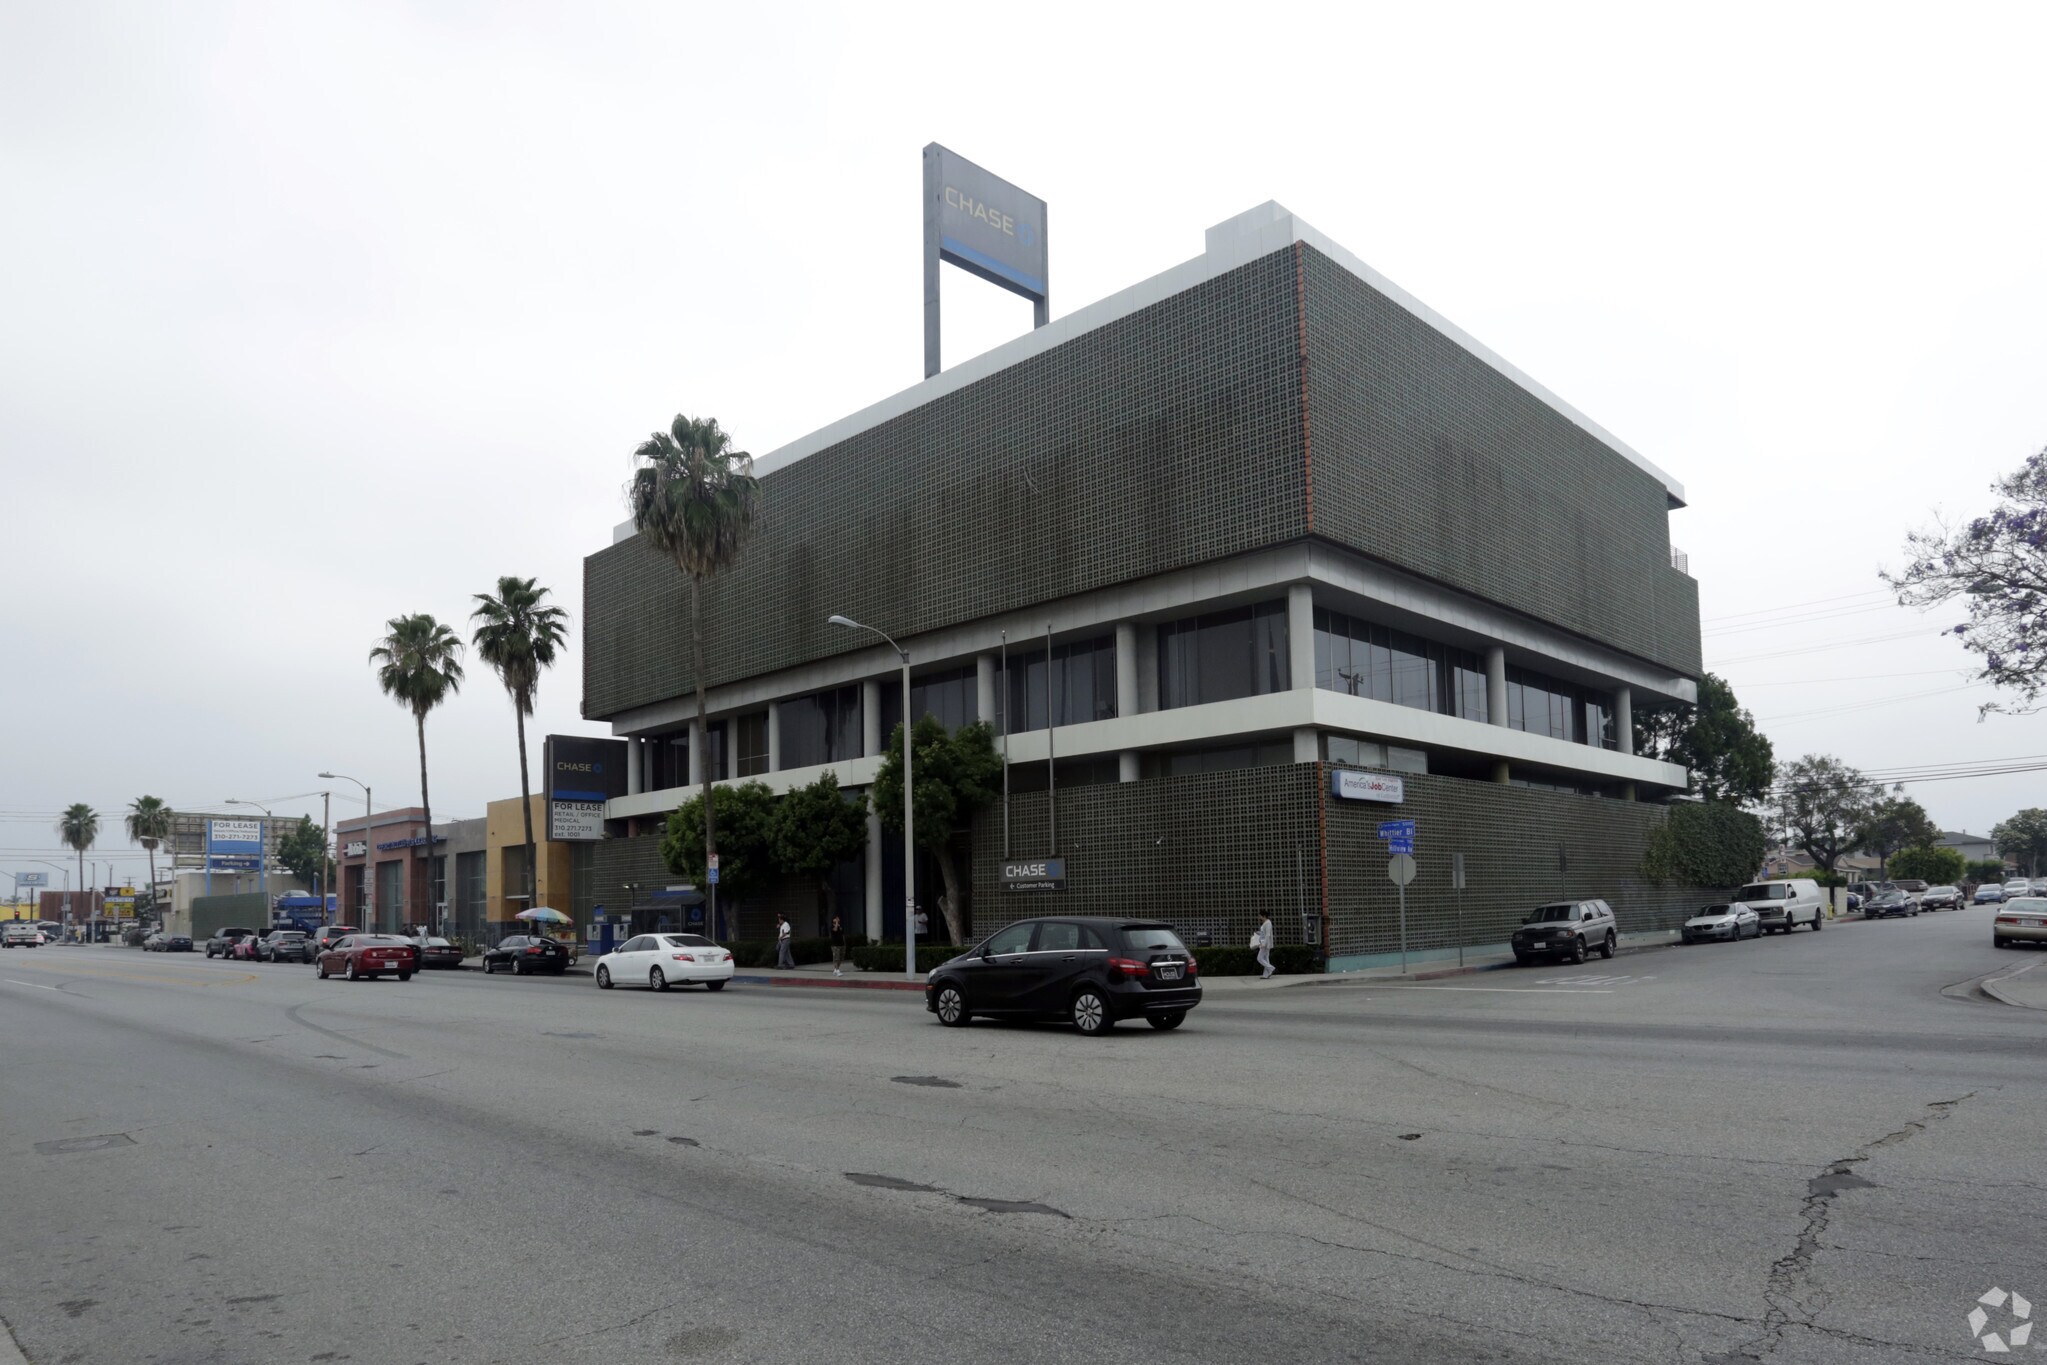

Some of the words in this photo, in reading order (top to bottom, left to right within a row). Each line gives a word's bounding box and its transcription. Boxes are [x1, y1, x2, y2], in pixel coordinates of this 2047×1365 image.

[945, 186, 1013, 236] CHASE
[557, 761, 592, 772] CHASE
[555, 802, 573, 810] FOR
[575, 803, 602, 812] LEASE
[1380, 829, 1403, 838] Whittier
[1006, 864, 1046, 877] CHASE
